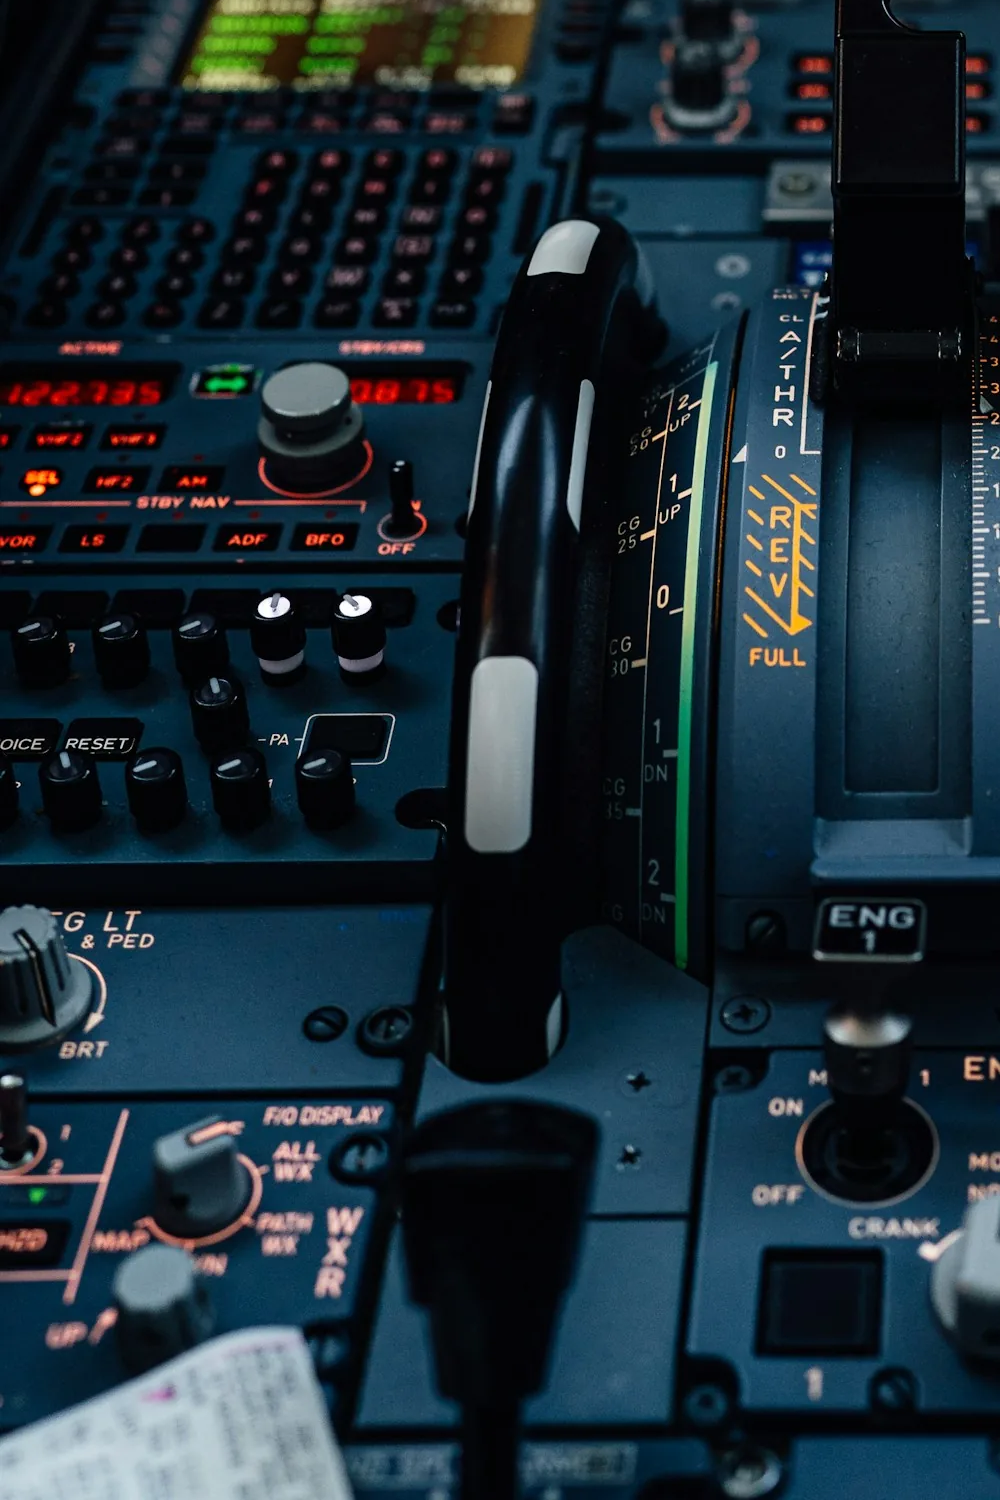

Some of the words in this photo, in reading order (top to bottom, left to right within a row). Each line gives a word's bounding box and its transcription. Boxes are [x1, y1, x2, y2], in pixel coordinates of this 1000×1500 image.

[780, 314, 804, 323] CL
[676, 394, 690, 412] 2
[669, 412, 691, 433] UP
[176, 475, 208, 488] AM
[669, 474, 678, 494] 1
[135, 495, 185, 510] STBY
[189, 495, 231, 510] NAV
[658, 503, 681, 525] UP
[617, 515, 641, 536] CG
[0, 533, 36, 548] VOR
[80, 533, 106, 547] LS
[227, 533, 268, 547] ADF
[305, 533, 345, 547] BFO
[378, 542, 416, 556] OFF
[617, 533, 638, 555] 25
[769, 505, 792, 598] REV
[656, 584, 670, 609] 0
[609, 635, 633, 656] CG
[749, 648, 806, 667] FULL
[269, 734, 290, 747] PA
[653, 717, 662, 745] 1
[0, 738, 46, 751] OICE
[65, 738, 130, 751] RESET
[644, 764, 669, 783] DN
[647, 859, 661, 886] 2
[103, 910, 142, 933] LT
[829, 904, 915, 929] ENG
[106, 933, 156, 949] PED
[861, 929, 874, 954] 1
[58, 1040, 110, 1060] BRT
[920, 1069, 930, 1087] 1
[263, 1105, 299, 1126] F/O
[299, 1105, 385, 1126] DISPLAY
[767, 1097, 804, 1117] ON
[272, 1140, 321, 1162] ALL
[751, 1184, 806, 1207] OFF
[847, 1216, 941, 1239] CRANK
[803, 1366, 824, 1401] 1
